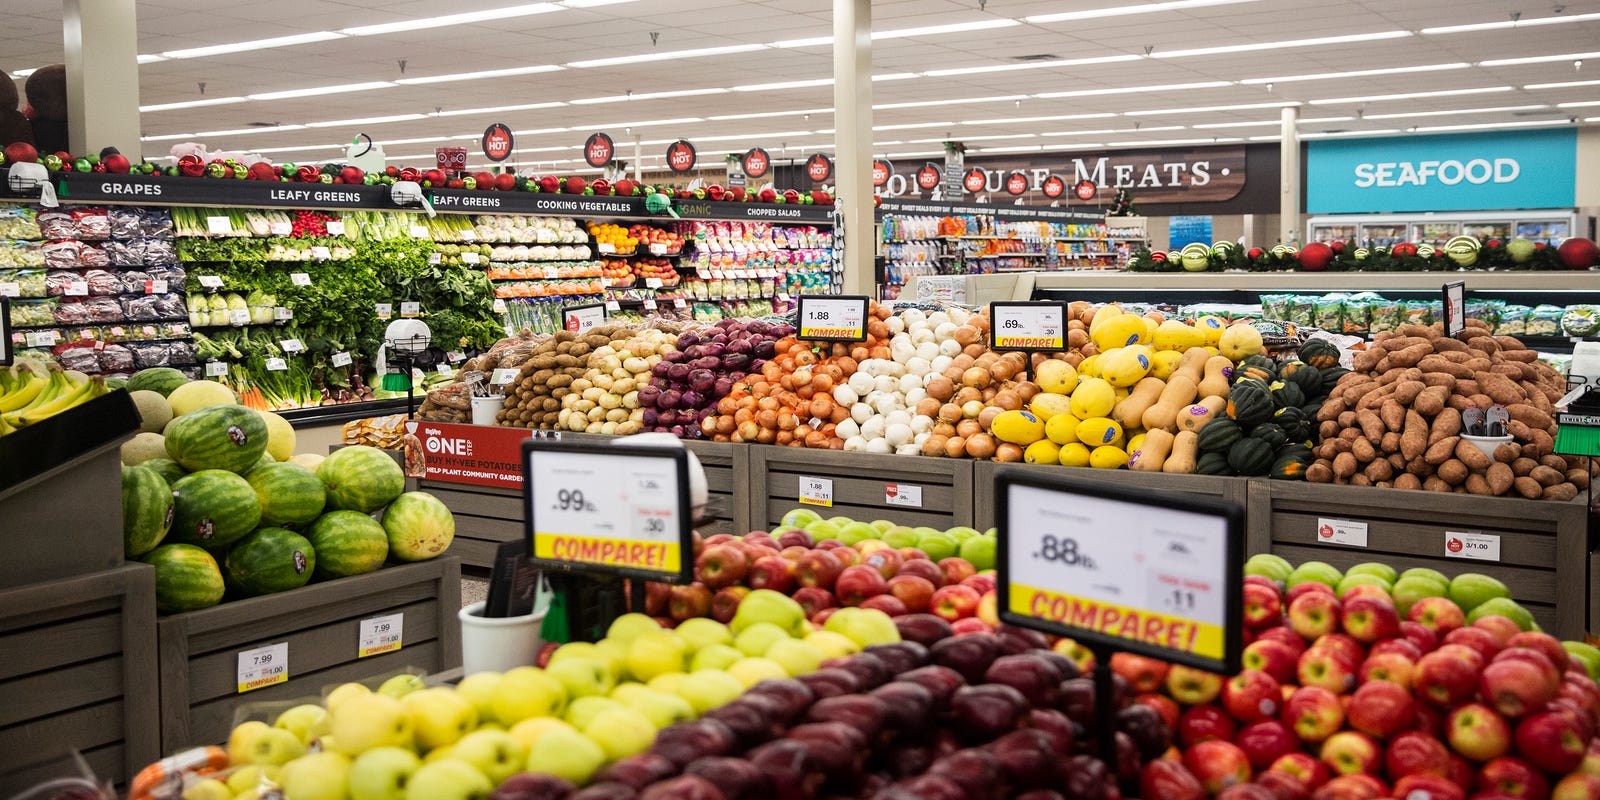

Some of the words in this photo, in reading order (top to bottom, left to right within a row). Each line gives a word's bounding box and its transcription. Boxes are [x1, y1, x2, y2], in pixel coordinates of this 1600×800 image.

[489, 141, 508, 150] HOT
[590, 149, 608, 158] HOT
[673, 155, 690, 164] HOT
[810, 167, 826, 175] HOT
[1354, 158, 1520, 188] SEAFOOD
[101, 182, 162, 196] GRAPES
[271, 189, 311, 201] LEAFY
[314, 191, 361, 203] GREENS
[433, 195, 460, 206] EAFY
[462, 197, 501, 207] GREENS
[537, 200, 577, 210] COOKING
[579, 201, 631, 212] VEGETABLES
[747, 208, 776, 217] CHOPPED
[777, 210, 801, 218] SALADS
[809, 311, 829, 320] 1.88
[807, 328, 857, 338] COMPARE!
[1002, 337, 1056, 347] COMPARE!
[426, 437, 467, 456] ONE
[427, 455, 443, 464] BUY
[427, 466, 442, 475] HELP
[442, 468, 461, 477] PLANT
[462, 471, 498, 480] COMMUNITY
[1466, 542, 1488, 550] 3/1.00
[553, 536, 667, 567] COMPARE!
[1030, 590, 1200, 653] COMPARE!
[374, 623, 391, 633] 7.99
[253, 654, 273, 665] 7.99
[269, 666, 283, 675] 1.00
[246, 674, 280, 689] COMPARE!
